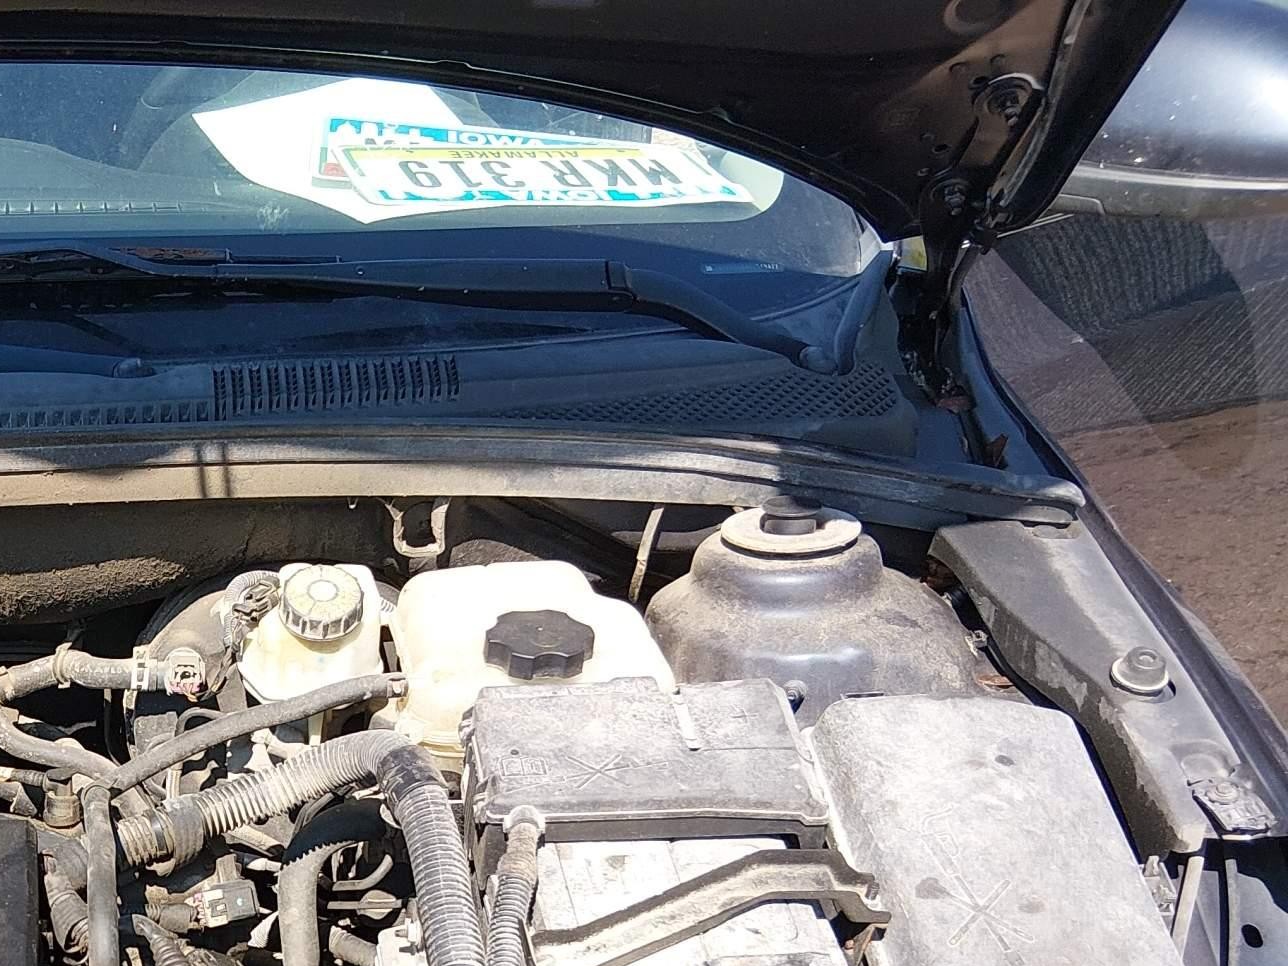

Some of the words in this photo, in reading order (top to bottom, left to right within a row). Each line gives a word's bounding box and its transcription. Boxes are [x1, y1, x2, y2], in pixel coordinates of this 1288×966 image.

[448, 130, 545, 146] IOWA
[448, 149, 579, 159] ALLAMAKEE
[398, 160, 526, 188] 319
[539, 158, 683, 187] MKR
